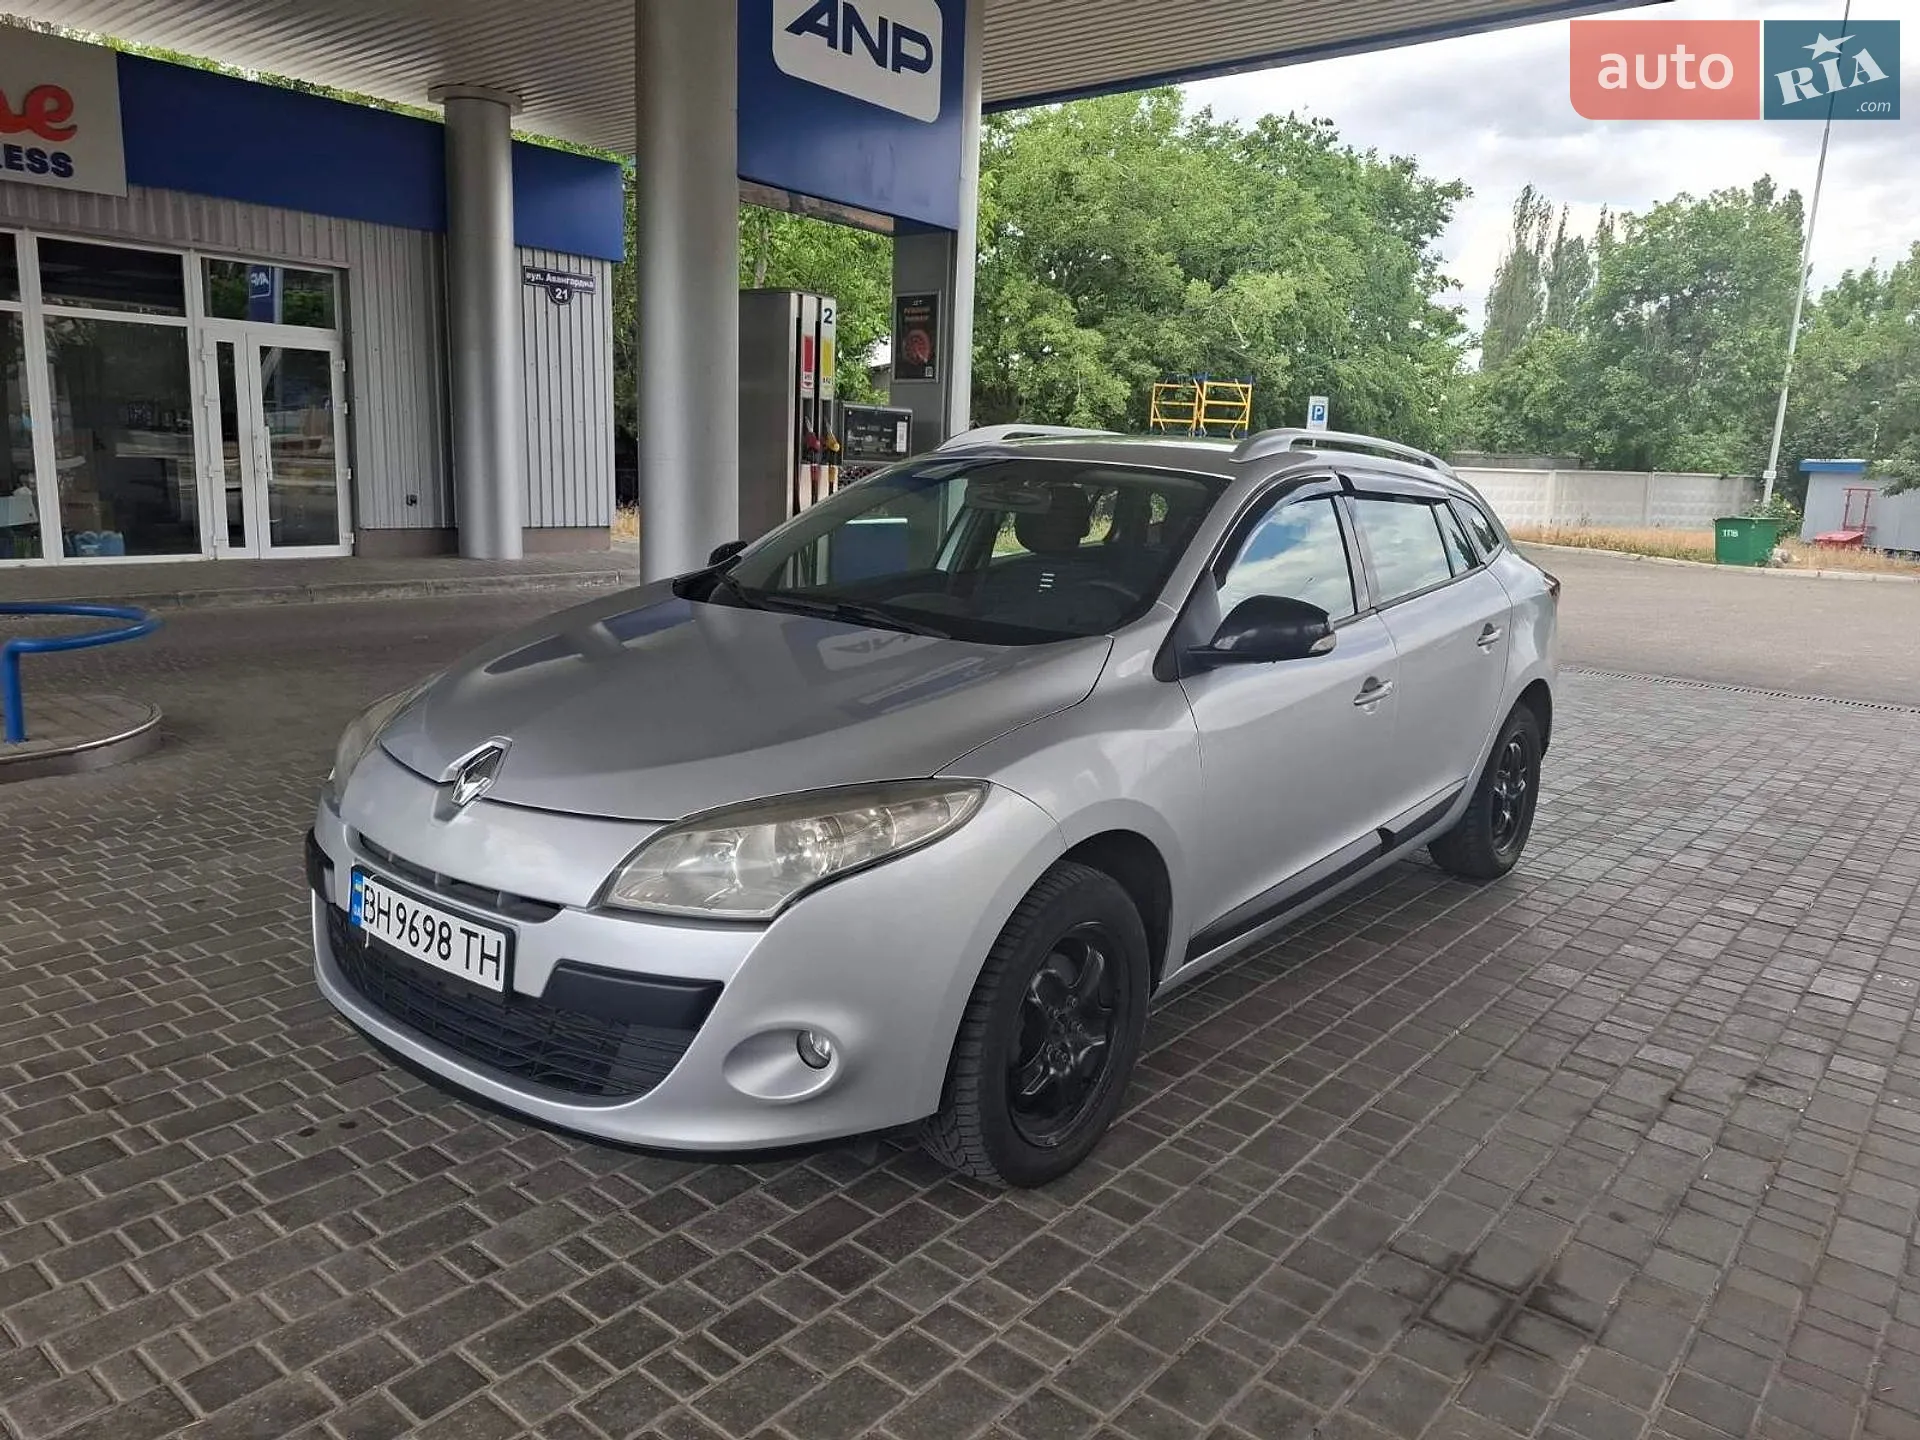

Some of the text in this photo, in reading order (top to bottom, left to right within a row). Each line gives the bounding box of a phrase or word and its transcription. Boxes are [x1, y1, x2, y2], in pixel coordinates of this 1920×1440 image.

[784, 0, 933, 74] ANP
[0, 143, 74, 178] ESS
[555, 288, 568, 300] 21
[823, 308, 833, 324] 2
[1314, 405, 1323, 420] P
[396, 902, 452, 961] 9698
[460, 926, 501, 981] TH
